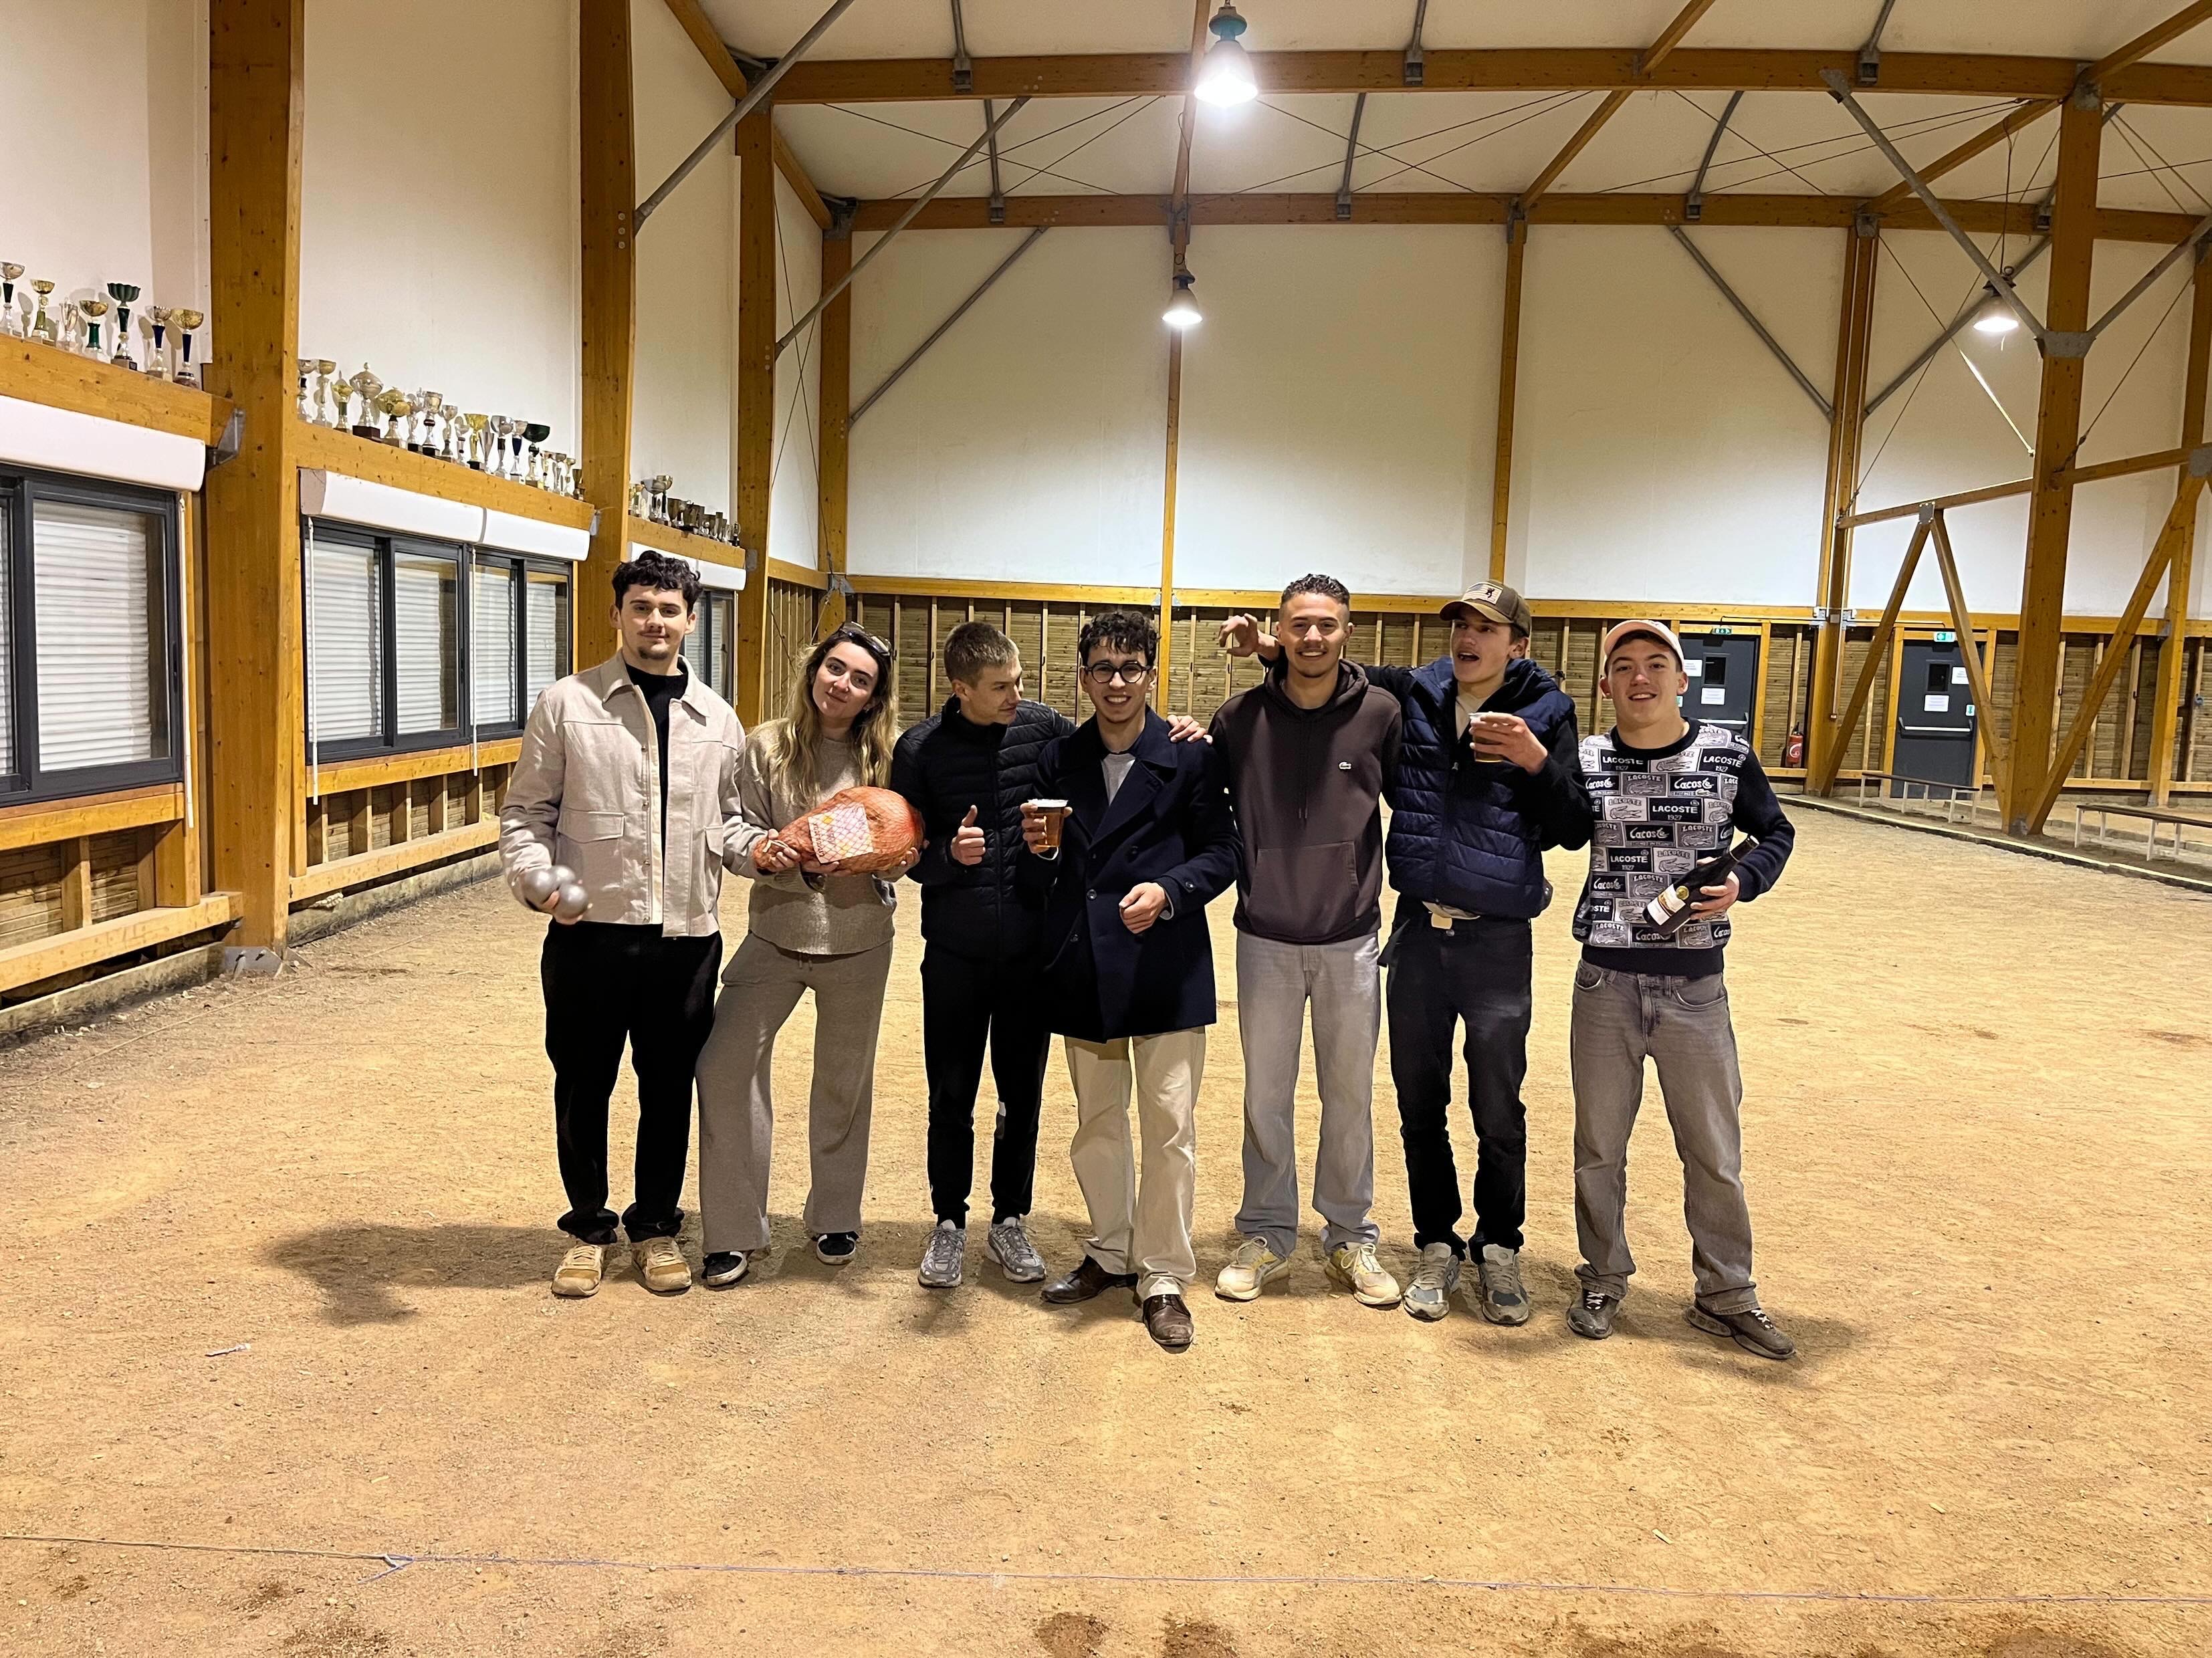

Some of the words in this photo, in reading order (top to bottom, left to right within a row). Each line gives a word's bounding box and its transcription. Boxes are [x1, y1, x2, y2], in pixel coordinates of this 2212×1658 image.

[1602, 755, 1644, 765] LACOSTE
[1703, 755, 1743, 767] LACOSTE
[1674, 778, 1714, 790] Lacoste
[1652, 806, 1698, 814] LACOSTE
[1630, 827, 1670, 839] Lacoste
[1634, 874, 1664, 883] LACOSTE
[1595, 923, 1625, 931] LACOSTE
